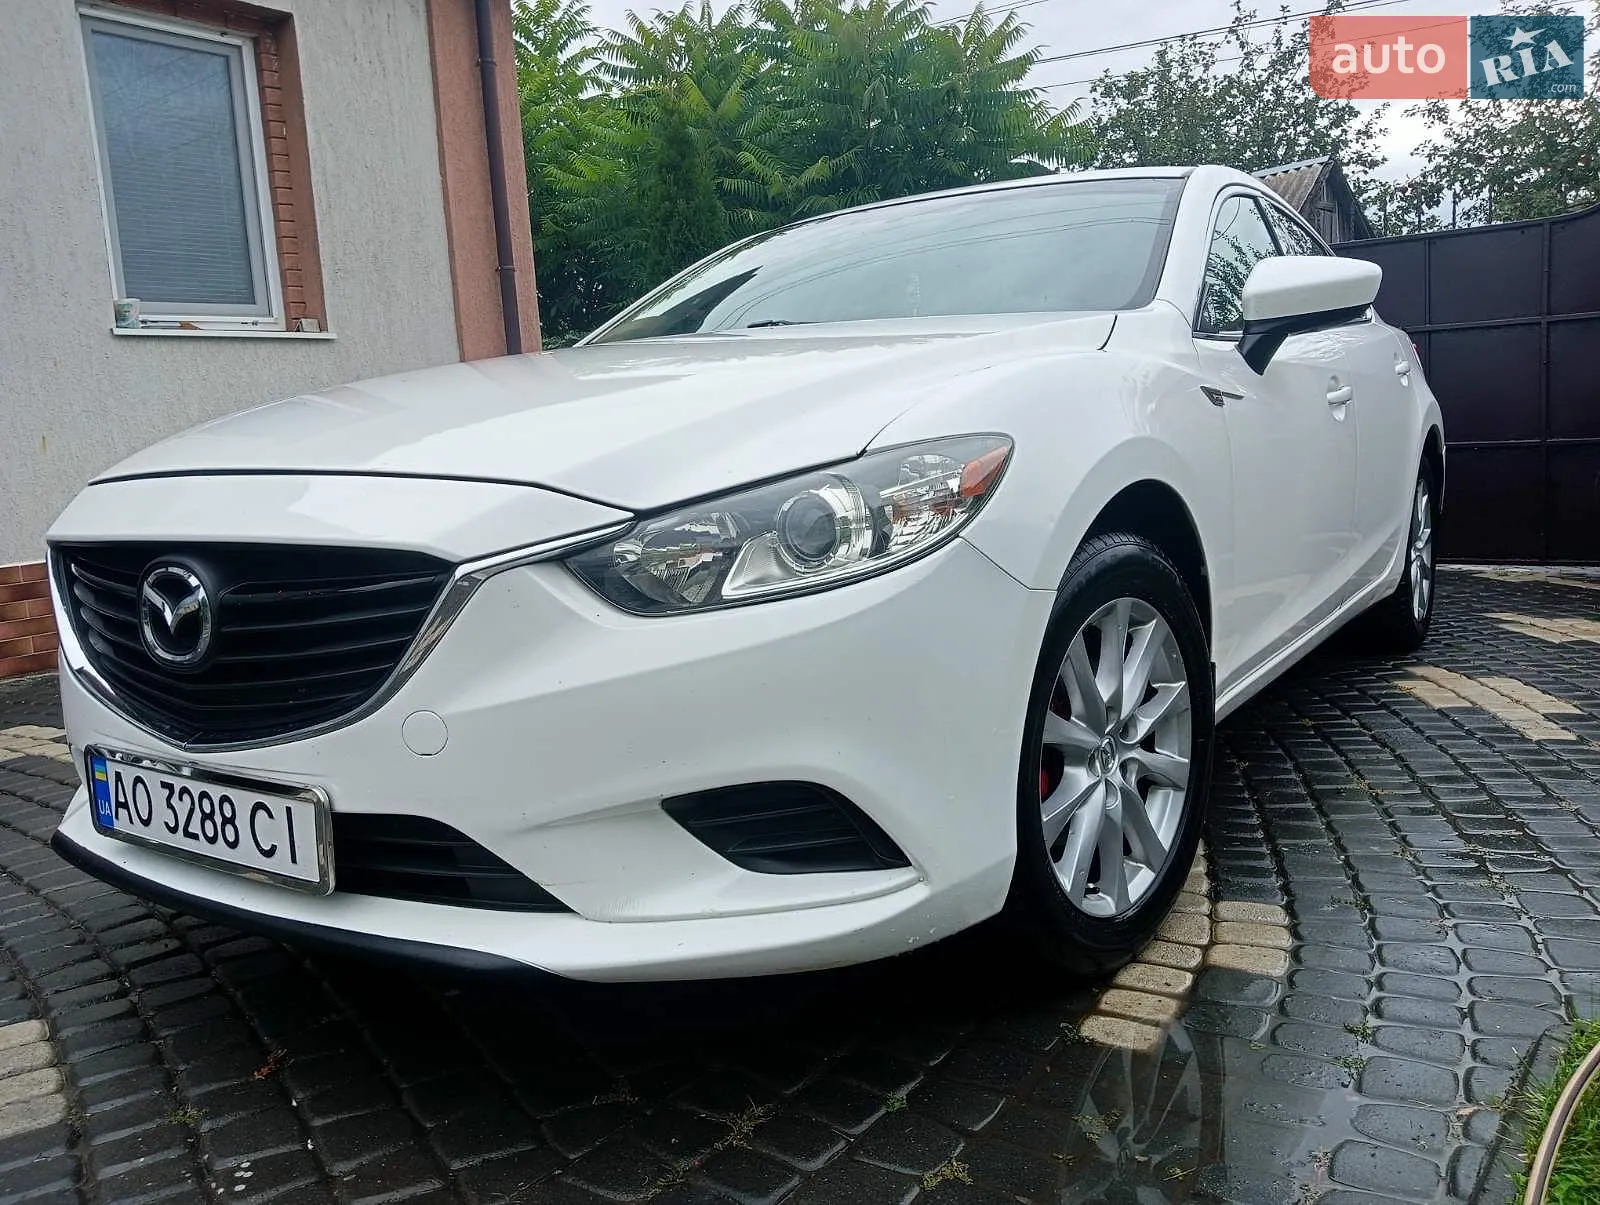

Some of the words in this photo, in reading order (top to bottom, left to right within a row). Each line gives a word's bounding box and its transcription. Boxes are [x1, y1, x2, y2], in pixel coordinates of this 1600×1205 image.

[99, 799, 111, 817] UA
[114, 770, 153, 827] AO
[160, 780, 240, 850] 3288
[249, 801, 298, 865] CI
